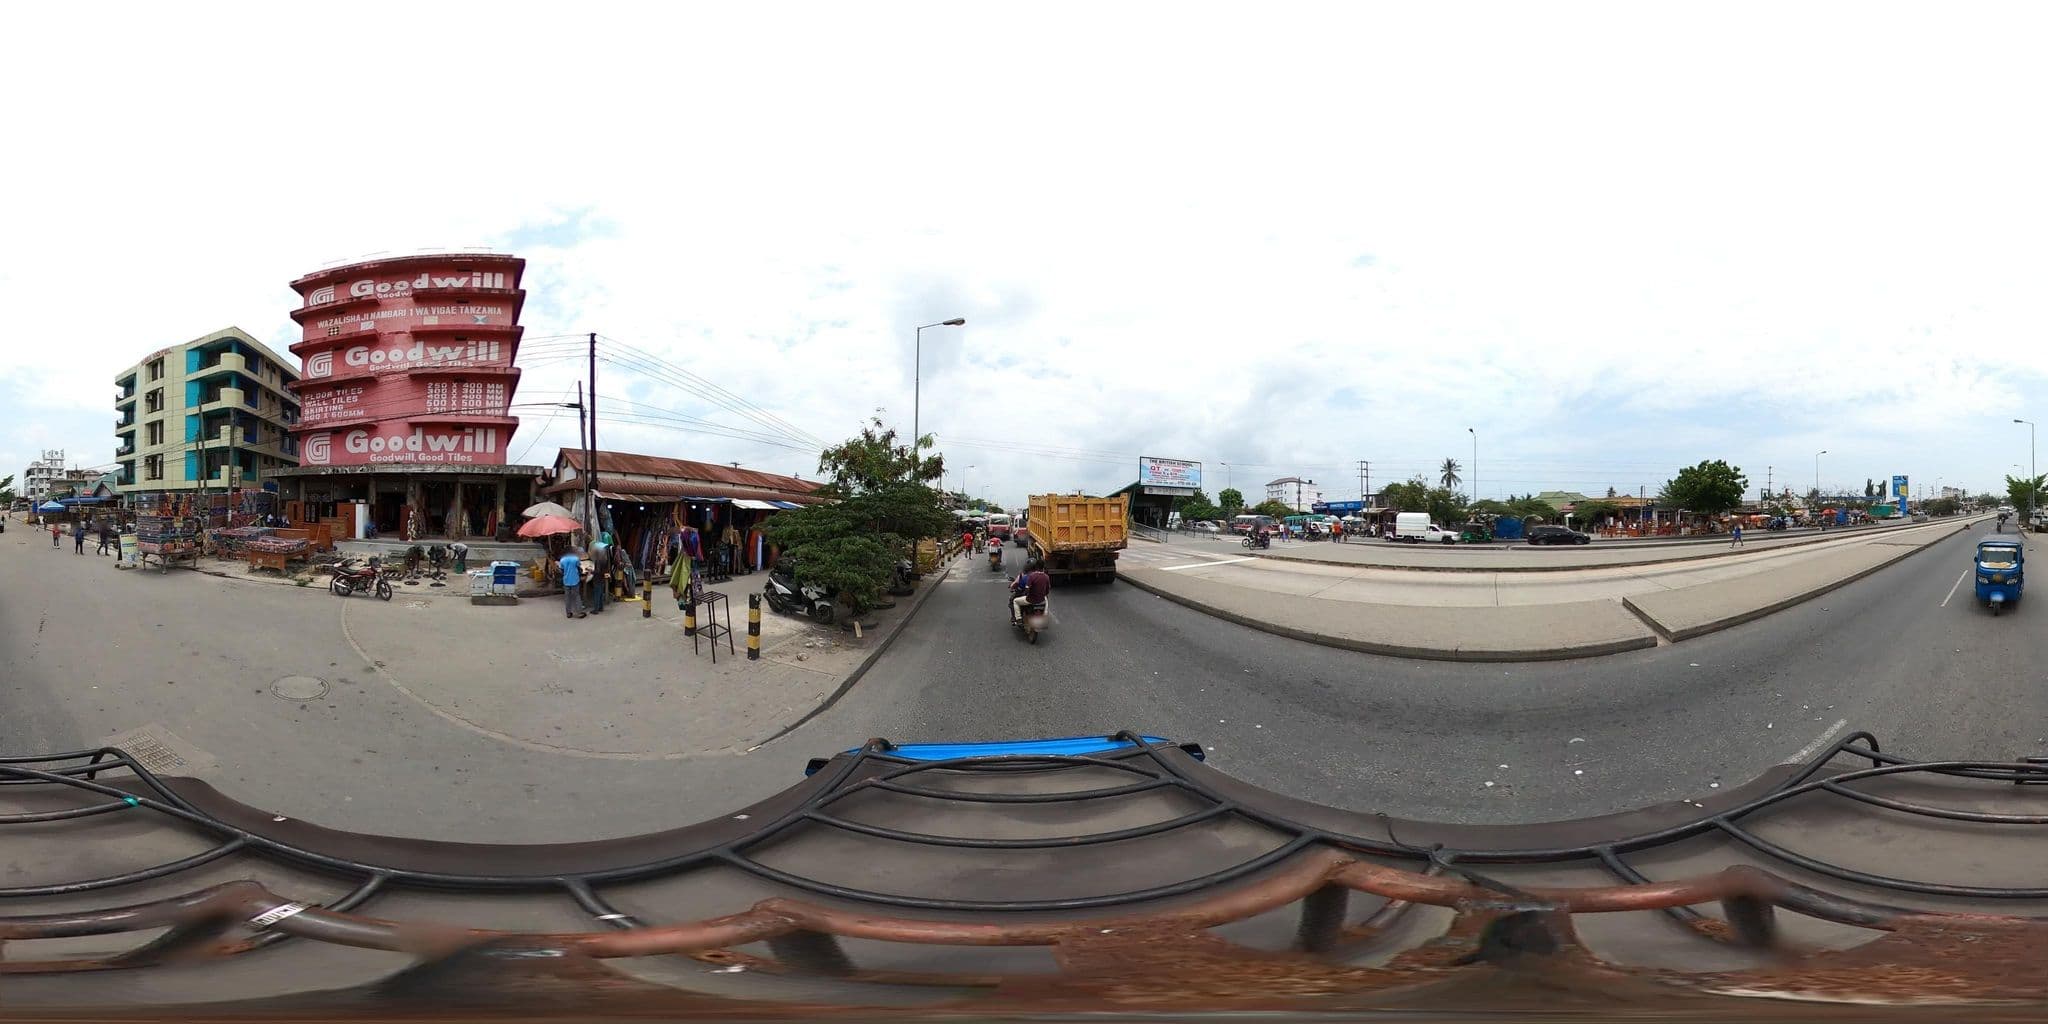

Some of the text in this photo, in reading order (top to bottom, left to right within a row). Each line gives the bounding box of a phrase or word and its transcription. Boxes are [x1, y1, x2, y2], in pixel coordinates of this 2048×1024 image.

[350, 272, 503, 297] Goodwill
[377, 290, 413, 299] Goodwi
[316, 306, 502, 328] WAZALISHAJI NAMBARI 1 WA VIGAE TANZANIA
[345, 341, 499, 367] Goodwill
[304, 387, 363, 401] FLOOR TILES
[332, 395, 358, 404] TILES
[304, 404, 343, 414] SKIRTING
[346, 427, 496, 454] Goodwill
[418, 453, 443, 462] Good
[449, 453, 472, 462] Tiles
